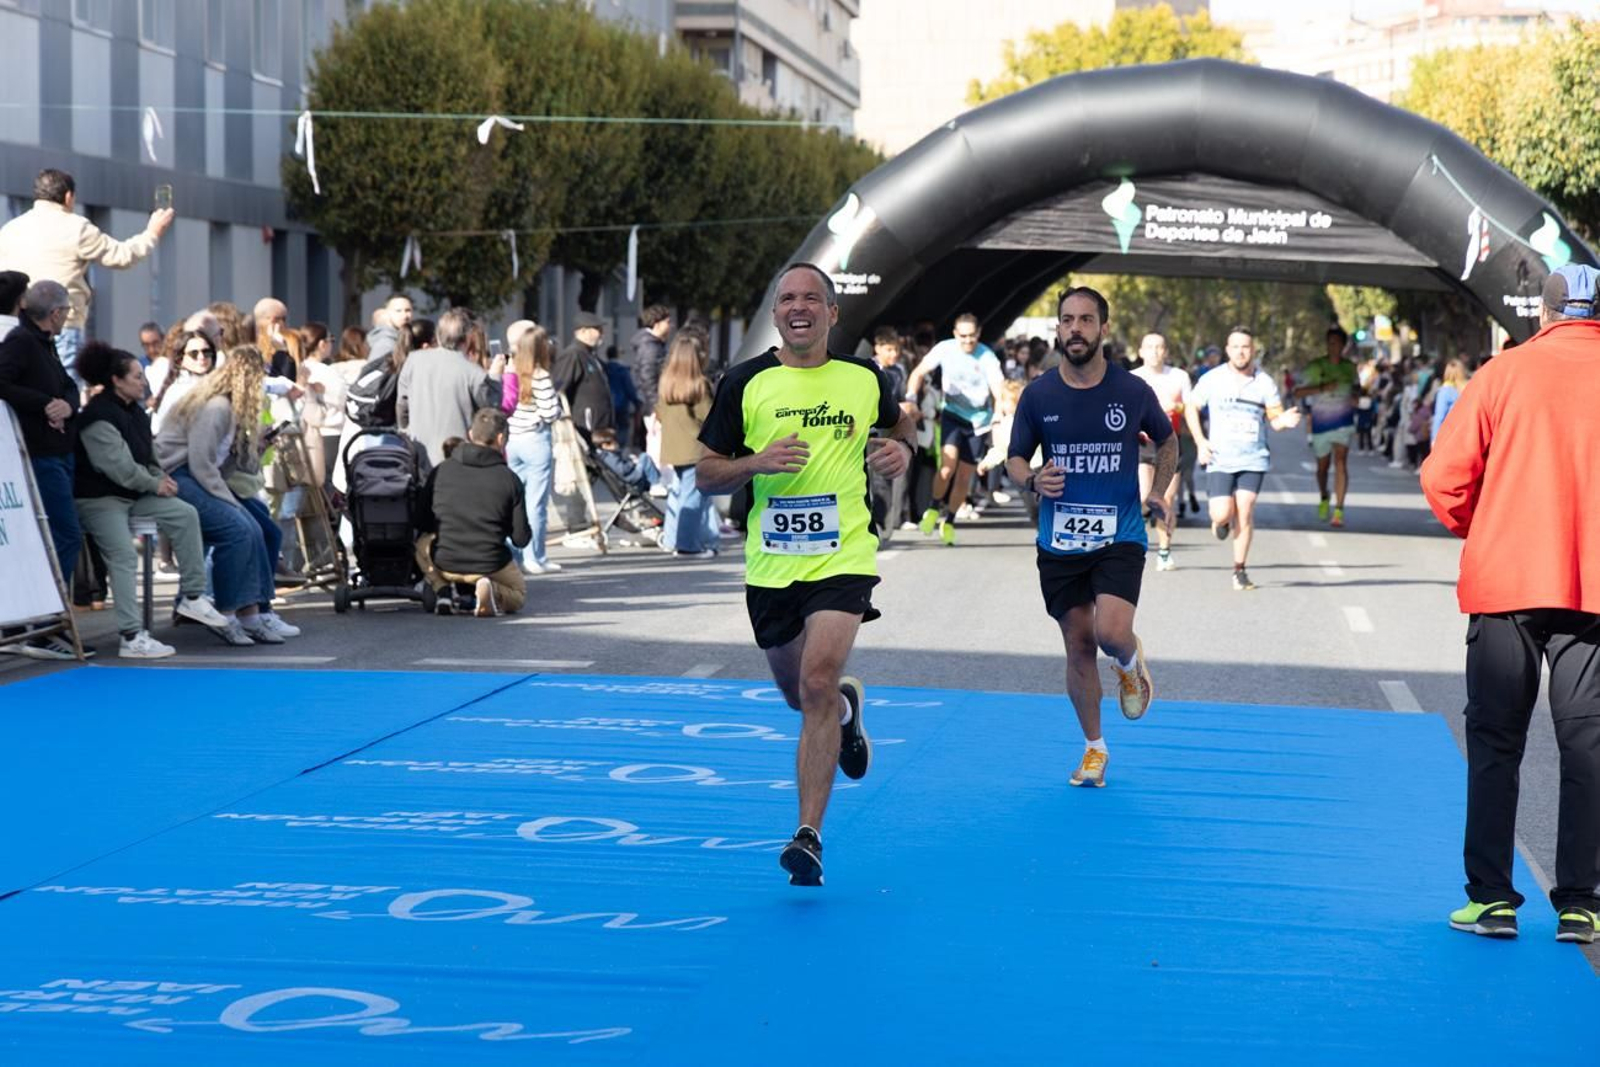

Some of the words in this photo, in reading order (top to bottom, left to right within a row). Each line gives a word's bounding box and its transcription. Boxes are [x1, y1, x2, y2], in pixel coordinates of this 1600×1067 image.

[1145, 204, 1224, 224] Patronato
[1227, 208, 1306, 229] Municipal
[1309, 212, 1332, 228] de
[1145, 223, 1219, 242] Deportes
[1222, 226, 1244, 242] de
[1247, 227, 1288, 244] Jaén
[802, 409, 855, 428] fondo
[1051, 443, 1068, 454] LUB
[1069, 442, 1122, 454] DEPORTIVO
[773, 512, 825, 533] 958
[1064, 517, 1105, 535] 424
[0, 990, 192, 1004] MAR
